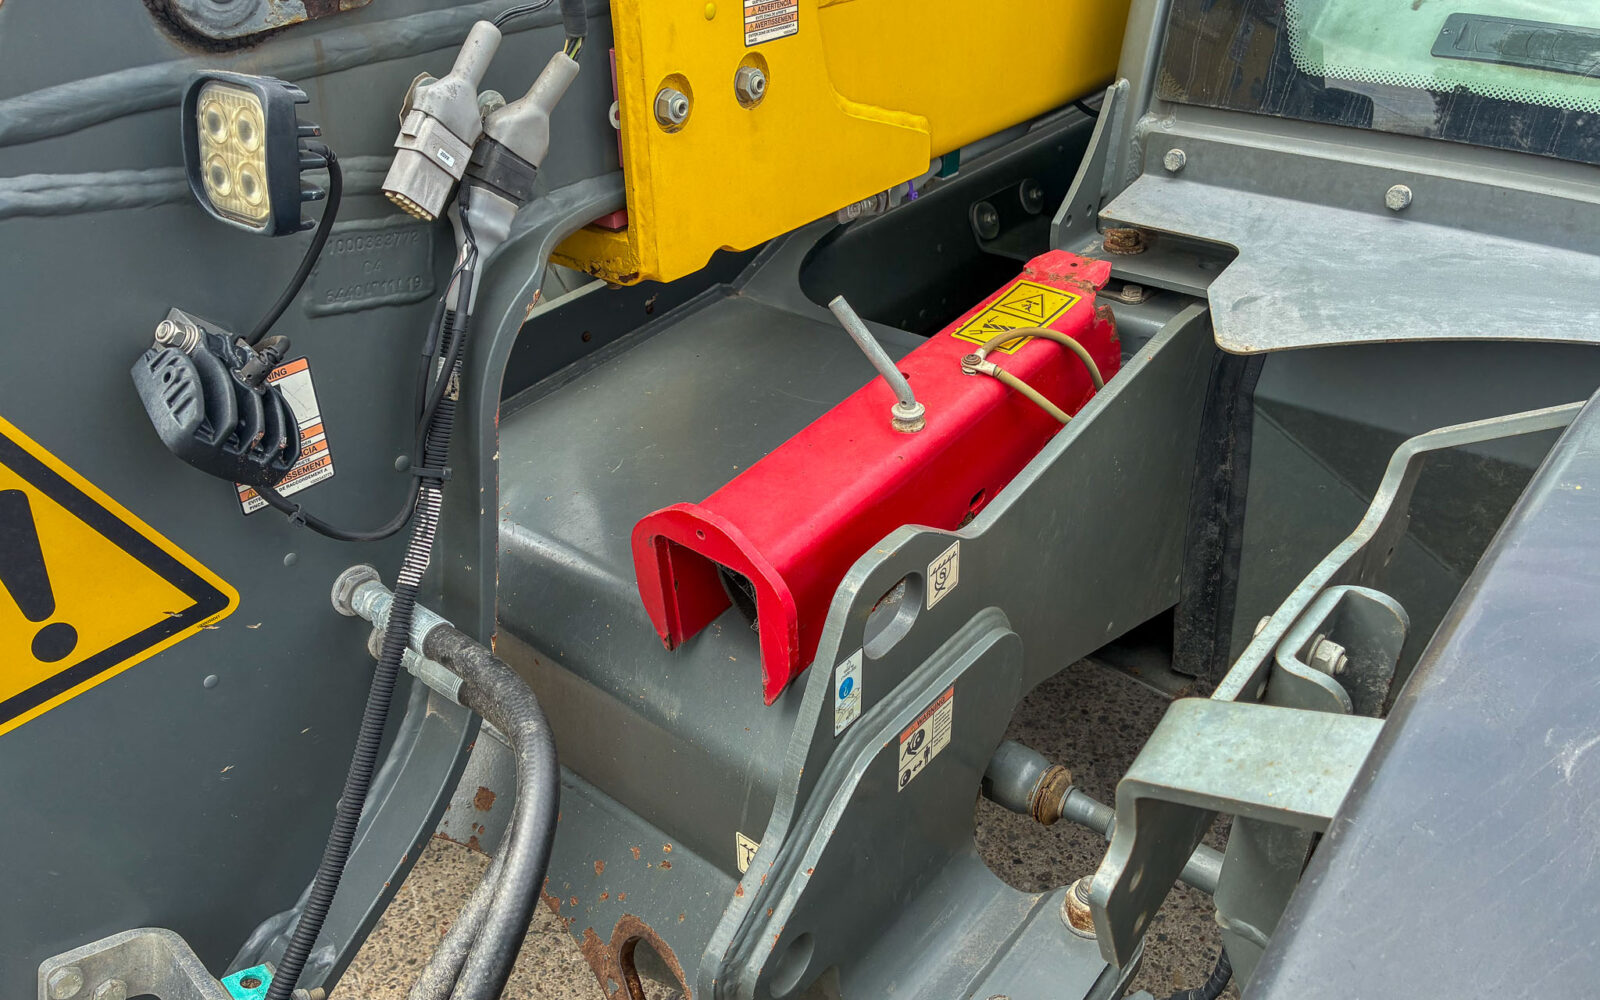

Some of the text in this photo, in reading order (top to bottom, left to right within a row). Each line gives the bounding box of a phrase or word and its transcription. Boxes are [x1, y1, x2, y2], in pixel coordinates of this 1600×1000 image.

[755, 14, 795, 29] AVERTISSEMENT
[282, 458, 326, 482] ISSEMENT
[247, 496, 263, 506] EVITE
[286, 470, 323, 489] RACCORDEMENT
[917, 696, 946, 726] WARNING
